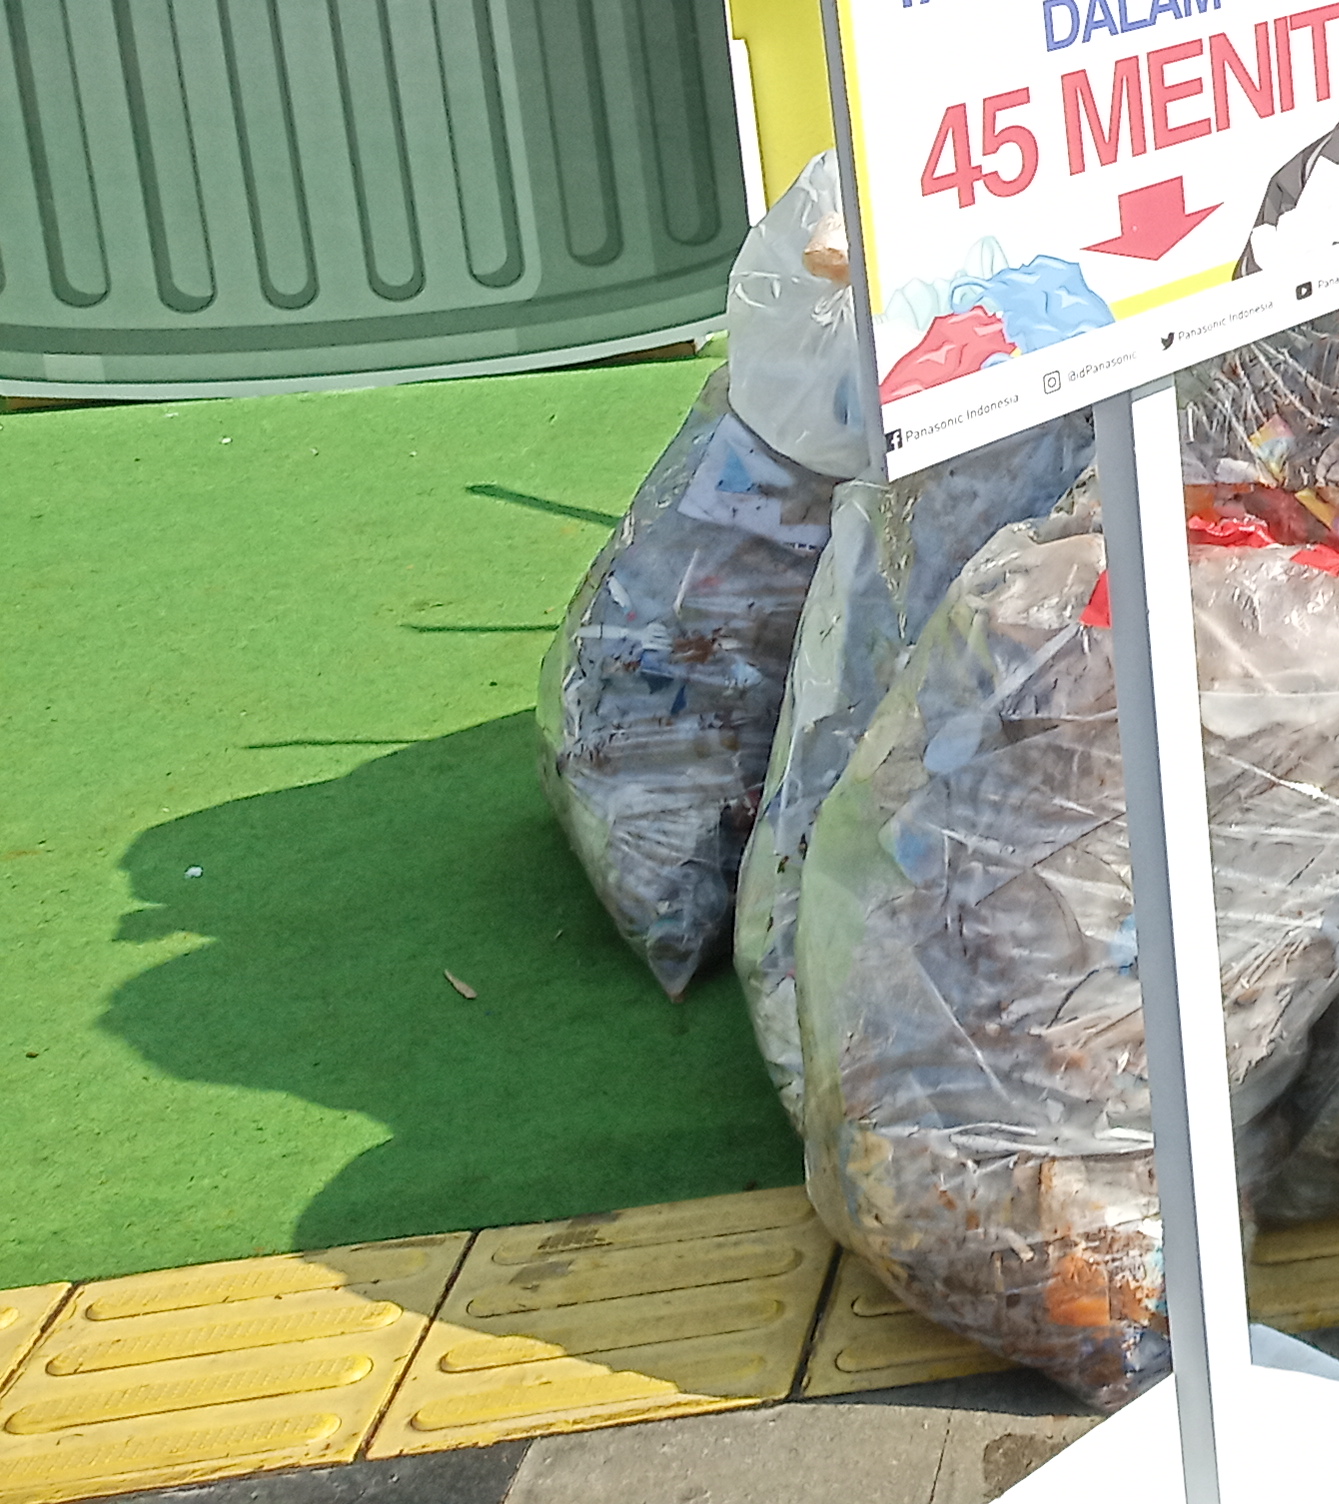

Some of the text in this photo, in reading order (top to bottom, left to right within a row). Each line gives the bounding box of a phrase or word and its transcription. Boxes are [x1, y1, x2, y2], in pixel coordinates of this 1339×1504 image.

[920, 86, 1039, 209] 45
[1177, 301, 1274, 341] Panasonic Indonesia
[1067, 351, 1137, 383] @idPanasonic
[905, 394, 1020, 443] Panasonic Indonesia
